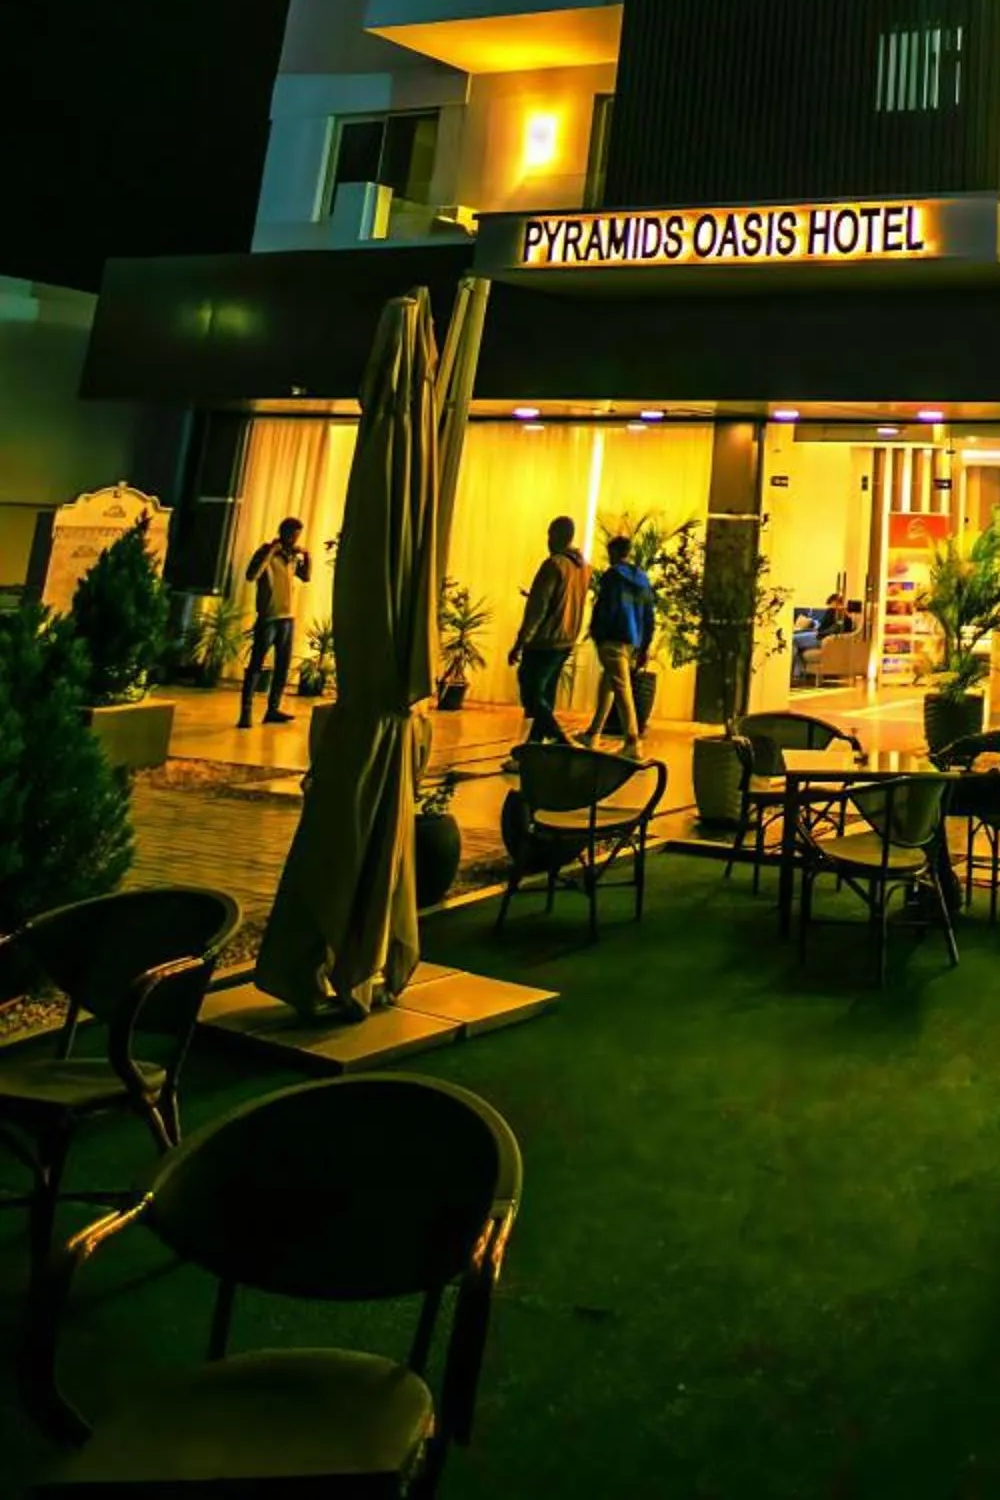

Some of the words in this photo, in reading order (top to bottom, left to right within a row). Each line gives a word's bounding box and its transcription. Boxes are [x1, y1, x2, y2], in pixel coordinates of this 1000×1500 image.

[522, 215, 684, 263] PYRAMIDS
[693, 212, 797, 258] OASIS
[807, 206, 924, 255] HOTEL
